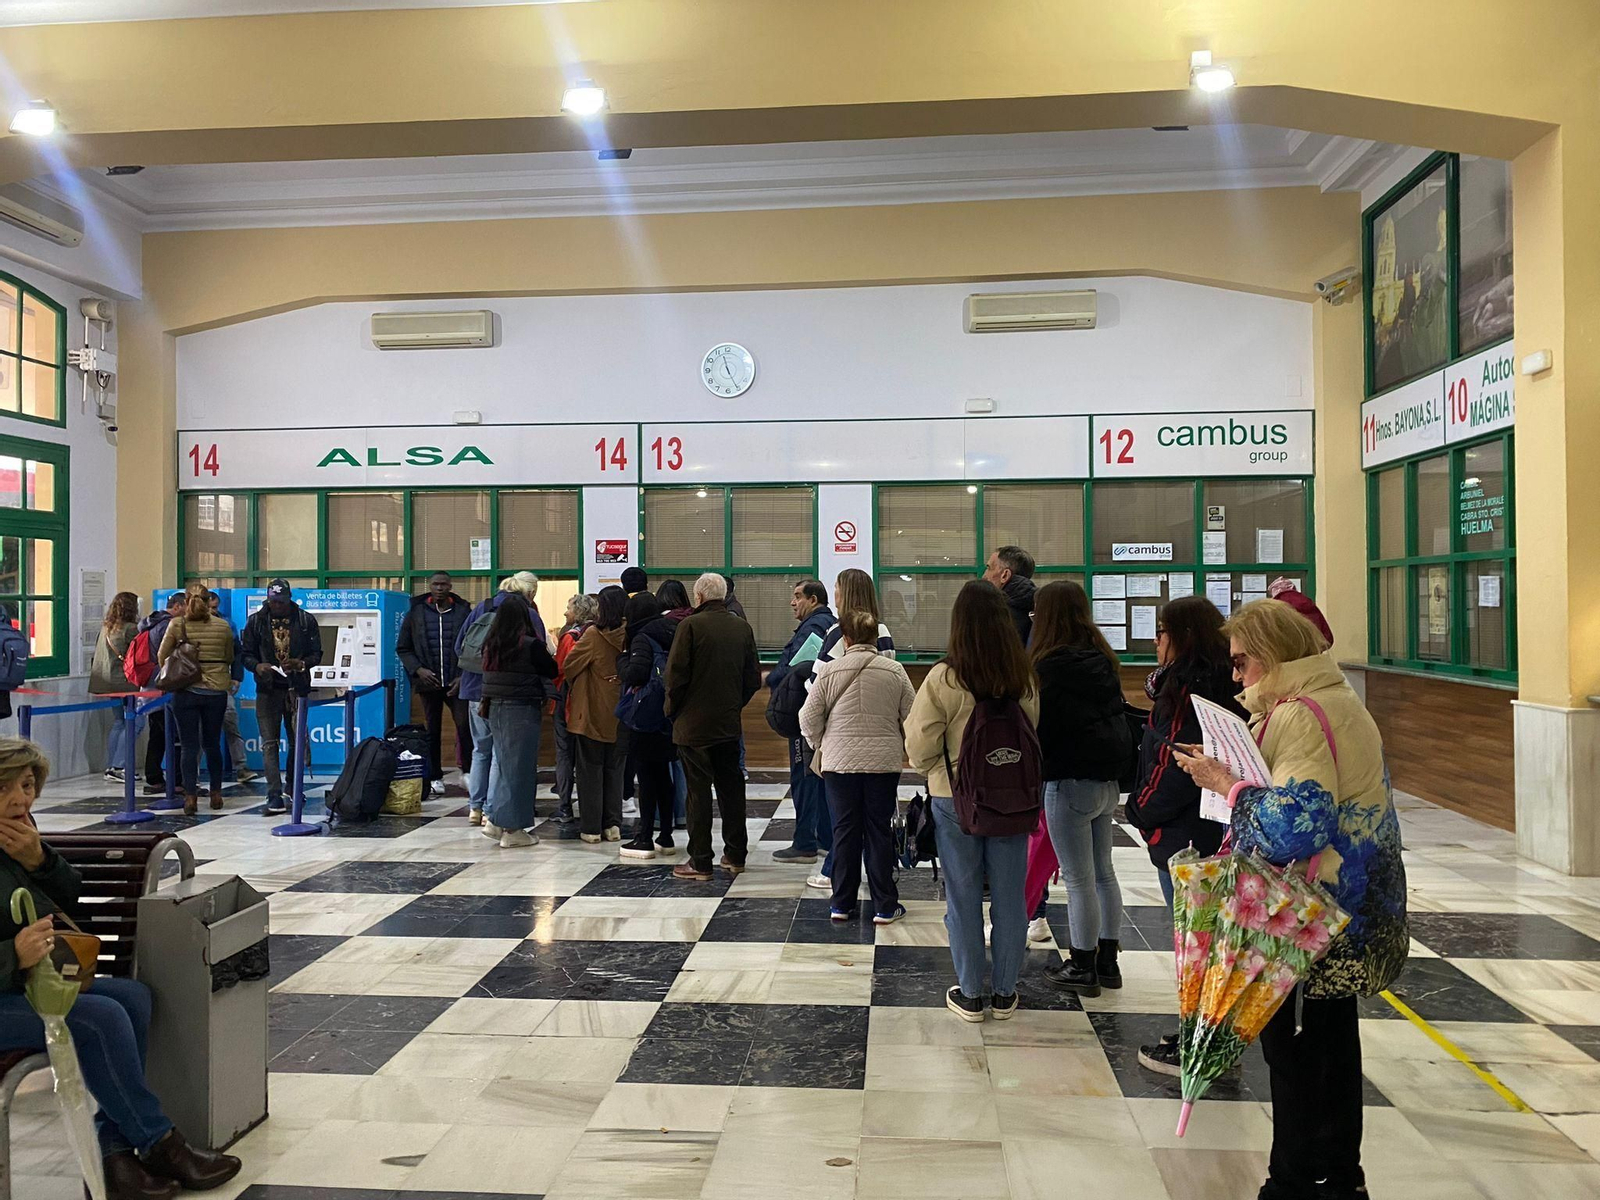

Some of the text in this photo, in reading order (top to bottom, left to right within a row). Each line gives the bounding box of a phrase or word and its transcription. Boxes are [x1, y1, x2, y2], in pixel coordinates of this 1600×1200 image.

[1448, 377, 1468, 425] 10
[1470, 390, 1510, 428] MÁGINA
[1157, 418, 1288, 447] cambus
[1363, 413, 1376, 454] 11
[1375, 419, 1394, 442] Hnos.
[316, 445, 495, 468] ALSA
[594, 437, 628, 471] 14
[651, 436, 684, 471] 13
[1099, 428, 1135, 464] 12
[1249, 450, 1288, 463] group
[189, 443, 220, 477] 14
[1461, 519, 1494, 535] HUELMA
[1128, 545, 1171, 555] cambus
[305, 592, 326, 600] Venta
[337, 592, 363, 600] billetes
[306, 600, 319, 608] Bus
[245, 735, 287, 752] ala
